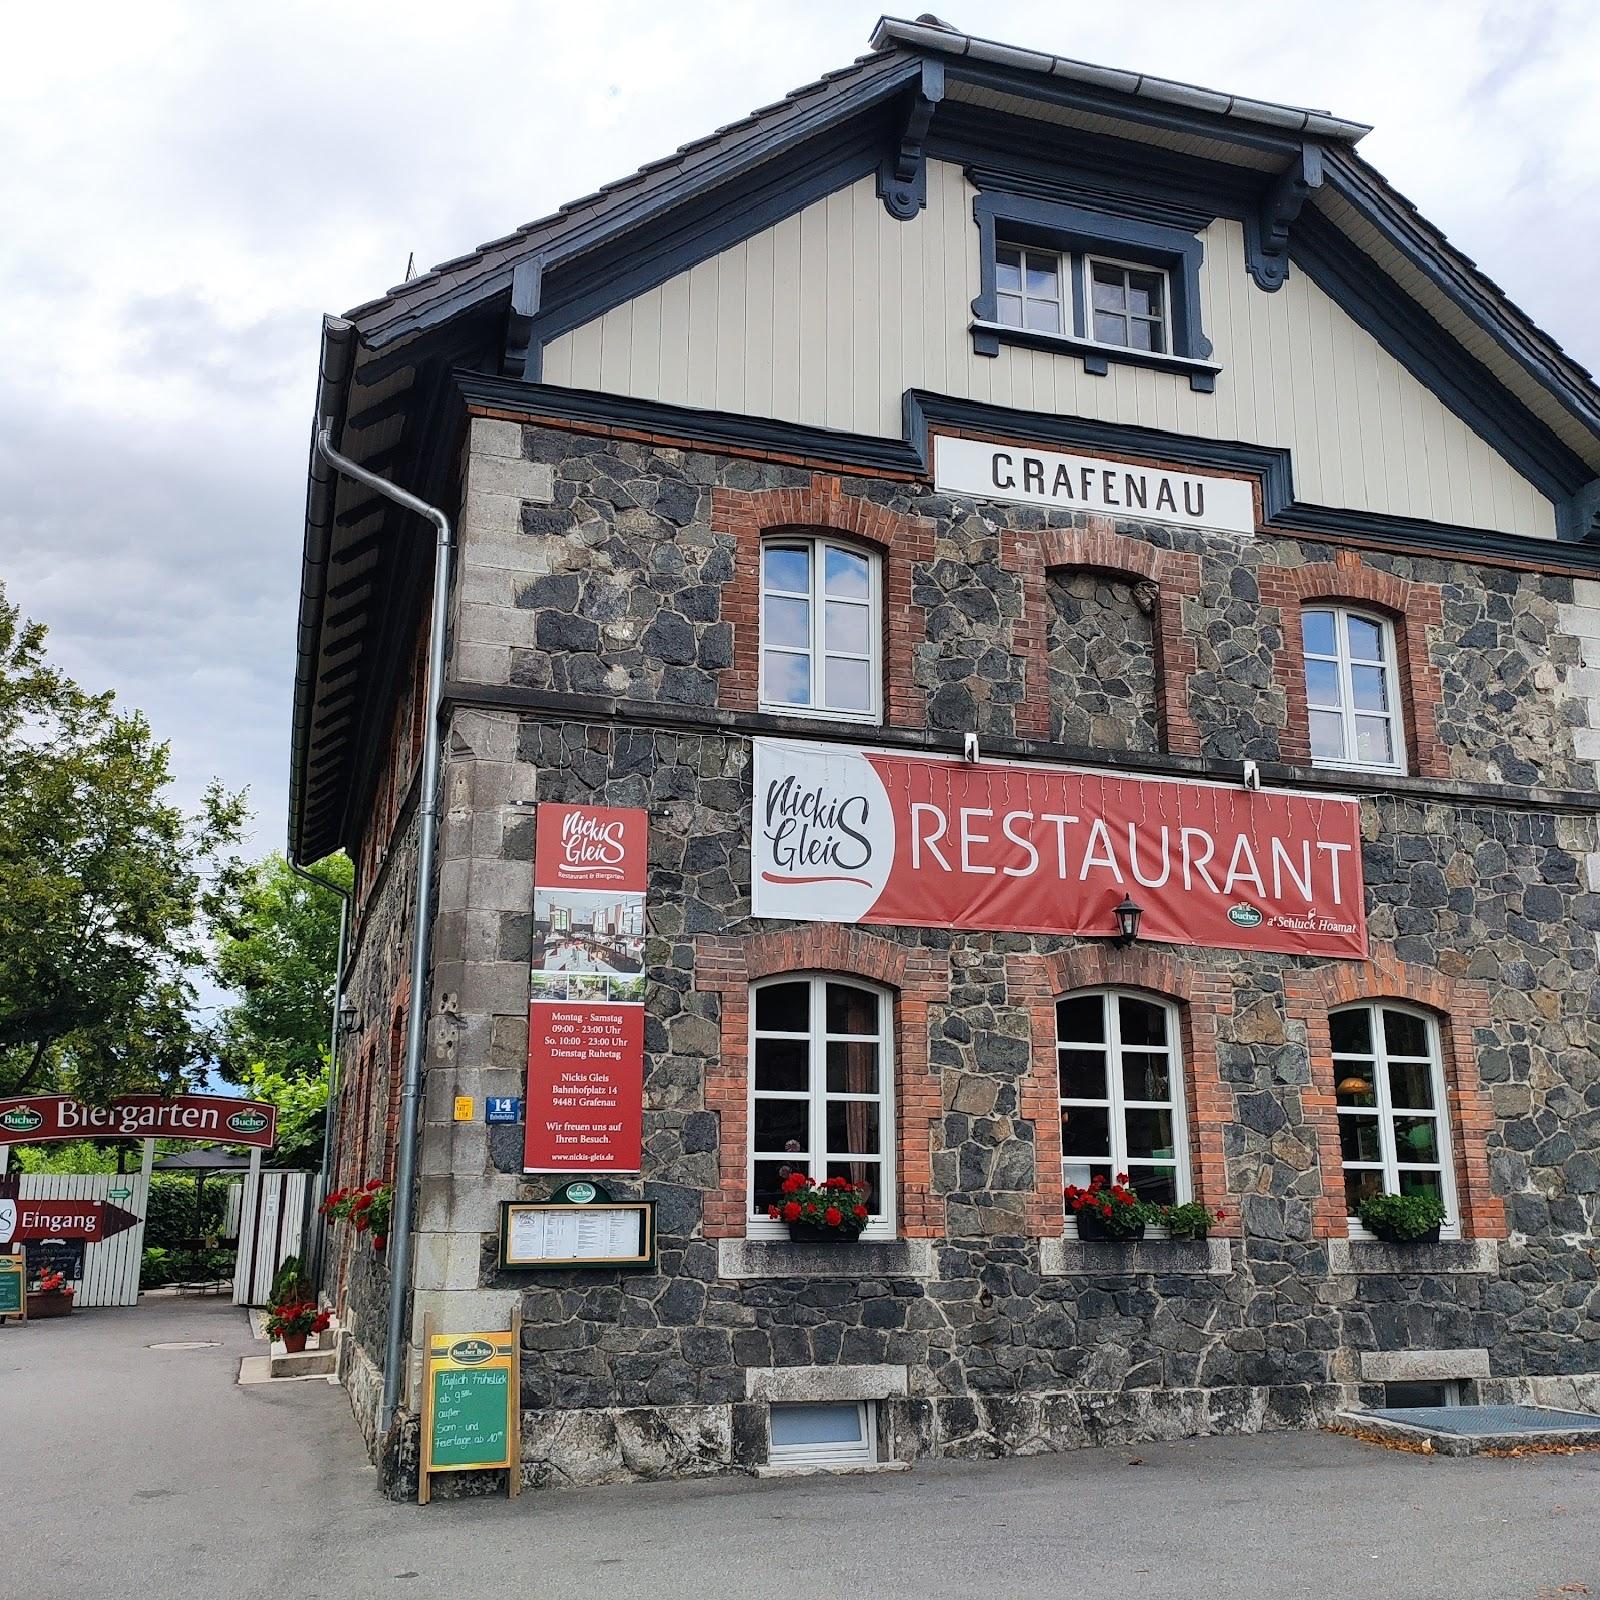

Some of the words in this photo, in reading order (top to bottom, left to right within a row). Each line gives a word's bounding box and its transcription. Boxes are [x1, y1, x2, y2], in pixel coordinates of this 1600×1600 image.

[991, 452, 1205, 518] GRAFENAU
[910, 801, 1352, 905] RESTAURANT
[557, 871, 589, 880] Restaurant
[589, 872, 595, 880] &
[595, 872, 625, 881] Biergarten
[1231, 910, 1259, 921] Bucher
[1318, 919, 1357, 934] Hoamat
[551, 1013, 583, 1025] Montag
[590, 1013, 623, 1025] Samstag
[551, 1025, 575, 1034] 09:00
[581, 1025, 604, 1034] 23:00
[604, 1025, 622, 1035] Uhr
[544, 1037, 557, 1046] So.
[559, 1037, 581, 1046] 10:00
[588, 1037, 610, 1046] 23:00
[611, 1037, 628, 1047] Uhr
[551, 1049, 587, 1059] Dienstag
[588, 1049, 622, 1060] Ruhetag
[561, 1073, 588, 1082] Nickis
[588, 1073, 610, 1082] Gleis
[552, 1085, 606, 1096] Bahnhofplatz
[608, 1086, 618, 1095] 14
[494, 1098, 512, 1112] 14
[552, 1098, 577, 1107] 94481
[579, 1098, 616, 1107] Grafenau
[4, 1114, 40, 1126] Bucher
[57, 1101, 219, 1133] Biergarten
[231, 1116, 265, 1128] Bucher
[546, 1122, 563, 1131] Wir
[564, 1121, 590, 1132] freuen
[591, 1124, 607, 1132] uns
[608, 1122, 623, 1132] auf
[555, 1135, 578, 1144] Ihren
[580, 1135, 612, 1144] Besuch.
[551, 1153, 614, 1162] www.nickis-gleis.de
[22, 1211, 97, 1232] Eingang
[439, 1373, 468, 1390] Täglich
[472, 1372, 507, 1385] Frühstück
[439, 1392, 451, 1404] ab
[465, 1422, 480, 1431] und
